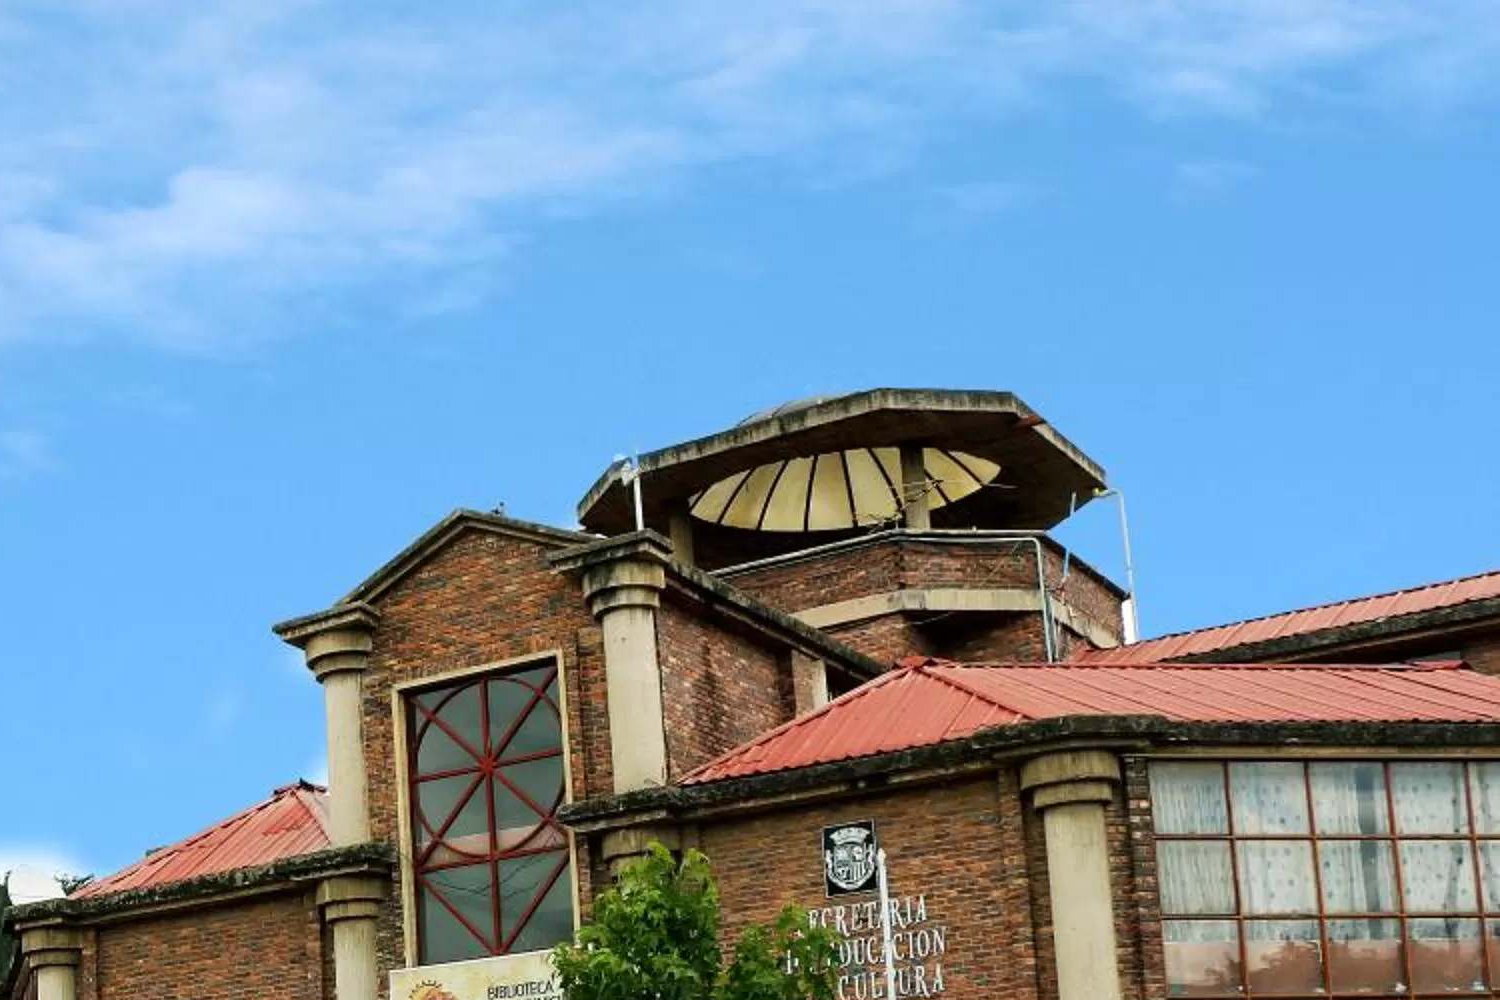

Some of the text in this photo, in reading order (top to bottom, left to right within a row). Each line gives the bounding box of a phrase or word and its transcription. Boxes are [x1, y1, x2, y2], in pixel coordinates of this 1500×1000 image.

[795, 893, 928, 938] ECRETRIA
[809, 926, 947, 976] DUCCION
[487, 980, 554, 1000] BIBLIOTECA
